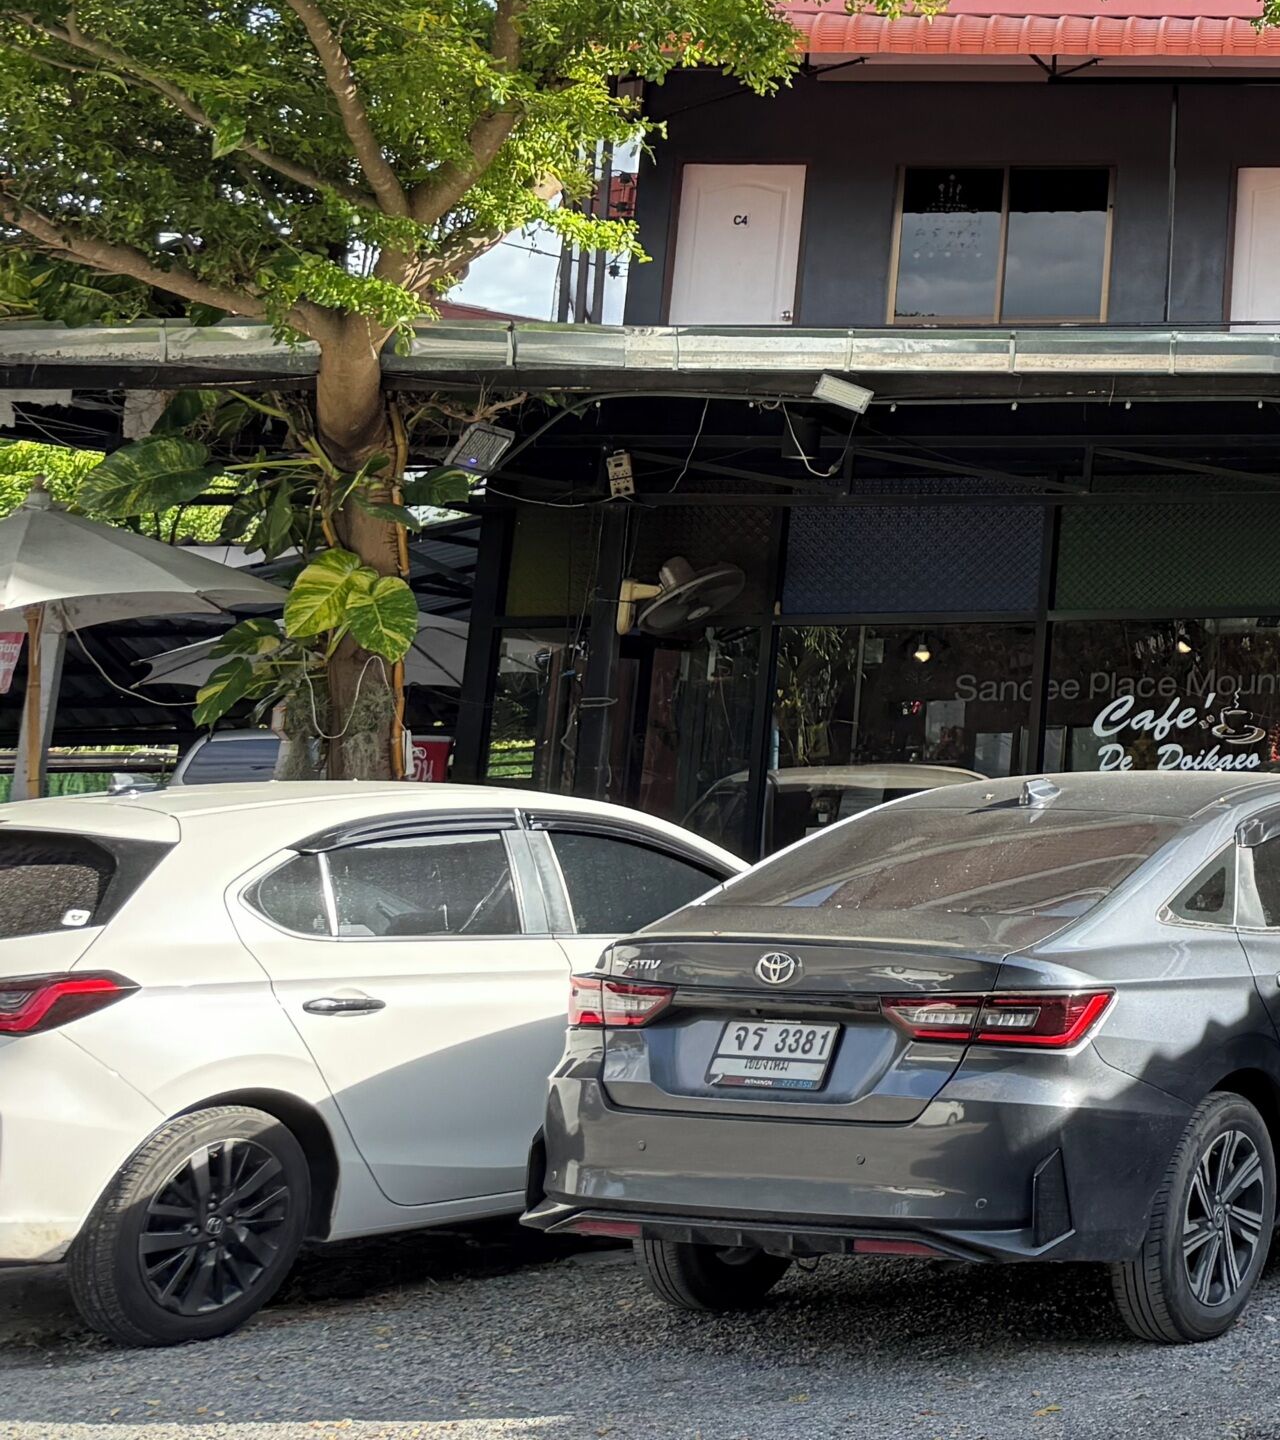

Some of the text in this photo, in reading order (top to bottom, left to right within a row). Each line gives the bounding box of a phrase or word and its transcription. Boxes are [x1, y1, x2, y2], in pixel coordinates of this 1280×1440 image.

[733, 215, 748, 226] C4
[1090, 672, 1177, 698] Place
[1098, 743, 1262, 771] De Doikaeo
[735, 1025, 831, 1056] จร 3381
